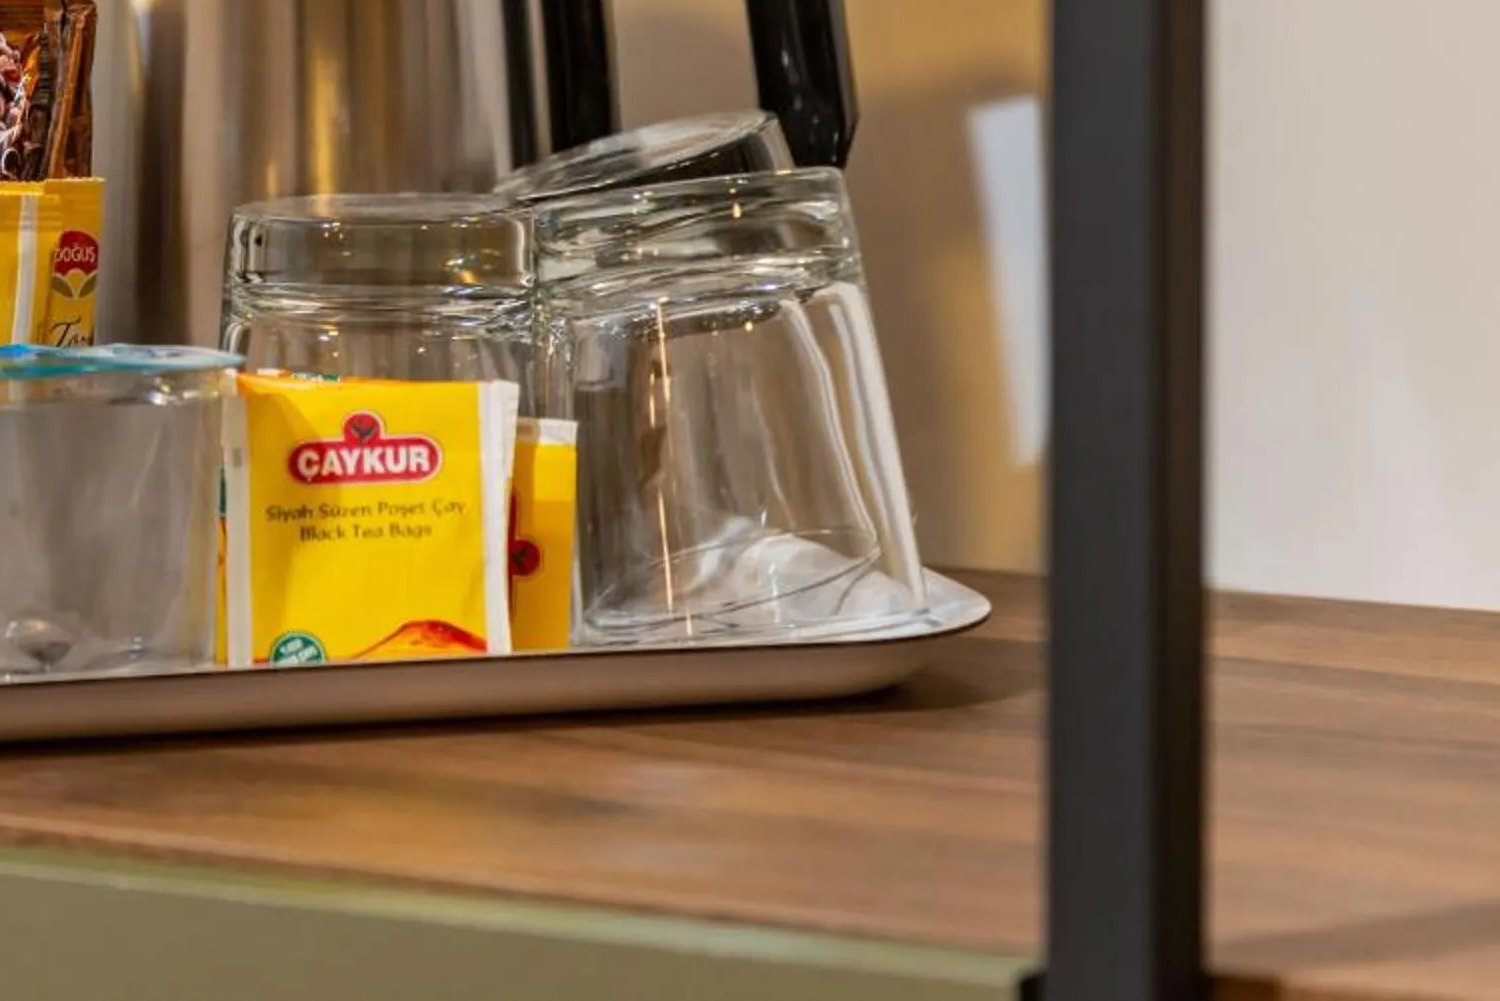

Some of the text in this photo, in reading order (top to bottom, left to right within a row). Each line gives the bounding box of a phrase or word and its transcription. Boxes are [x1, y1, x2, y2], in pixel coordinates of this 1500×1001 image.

[297, 445, 431, 482] ÇAYKUR
[265, 499, 466, 523] Siyah Süzen Poşet Çay
[300, 522, 433, 542] Black Tea Bags
